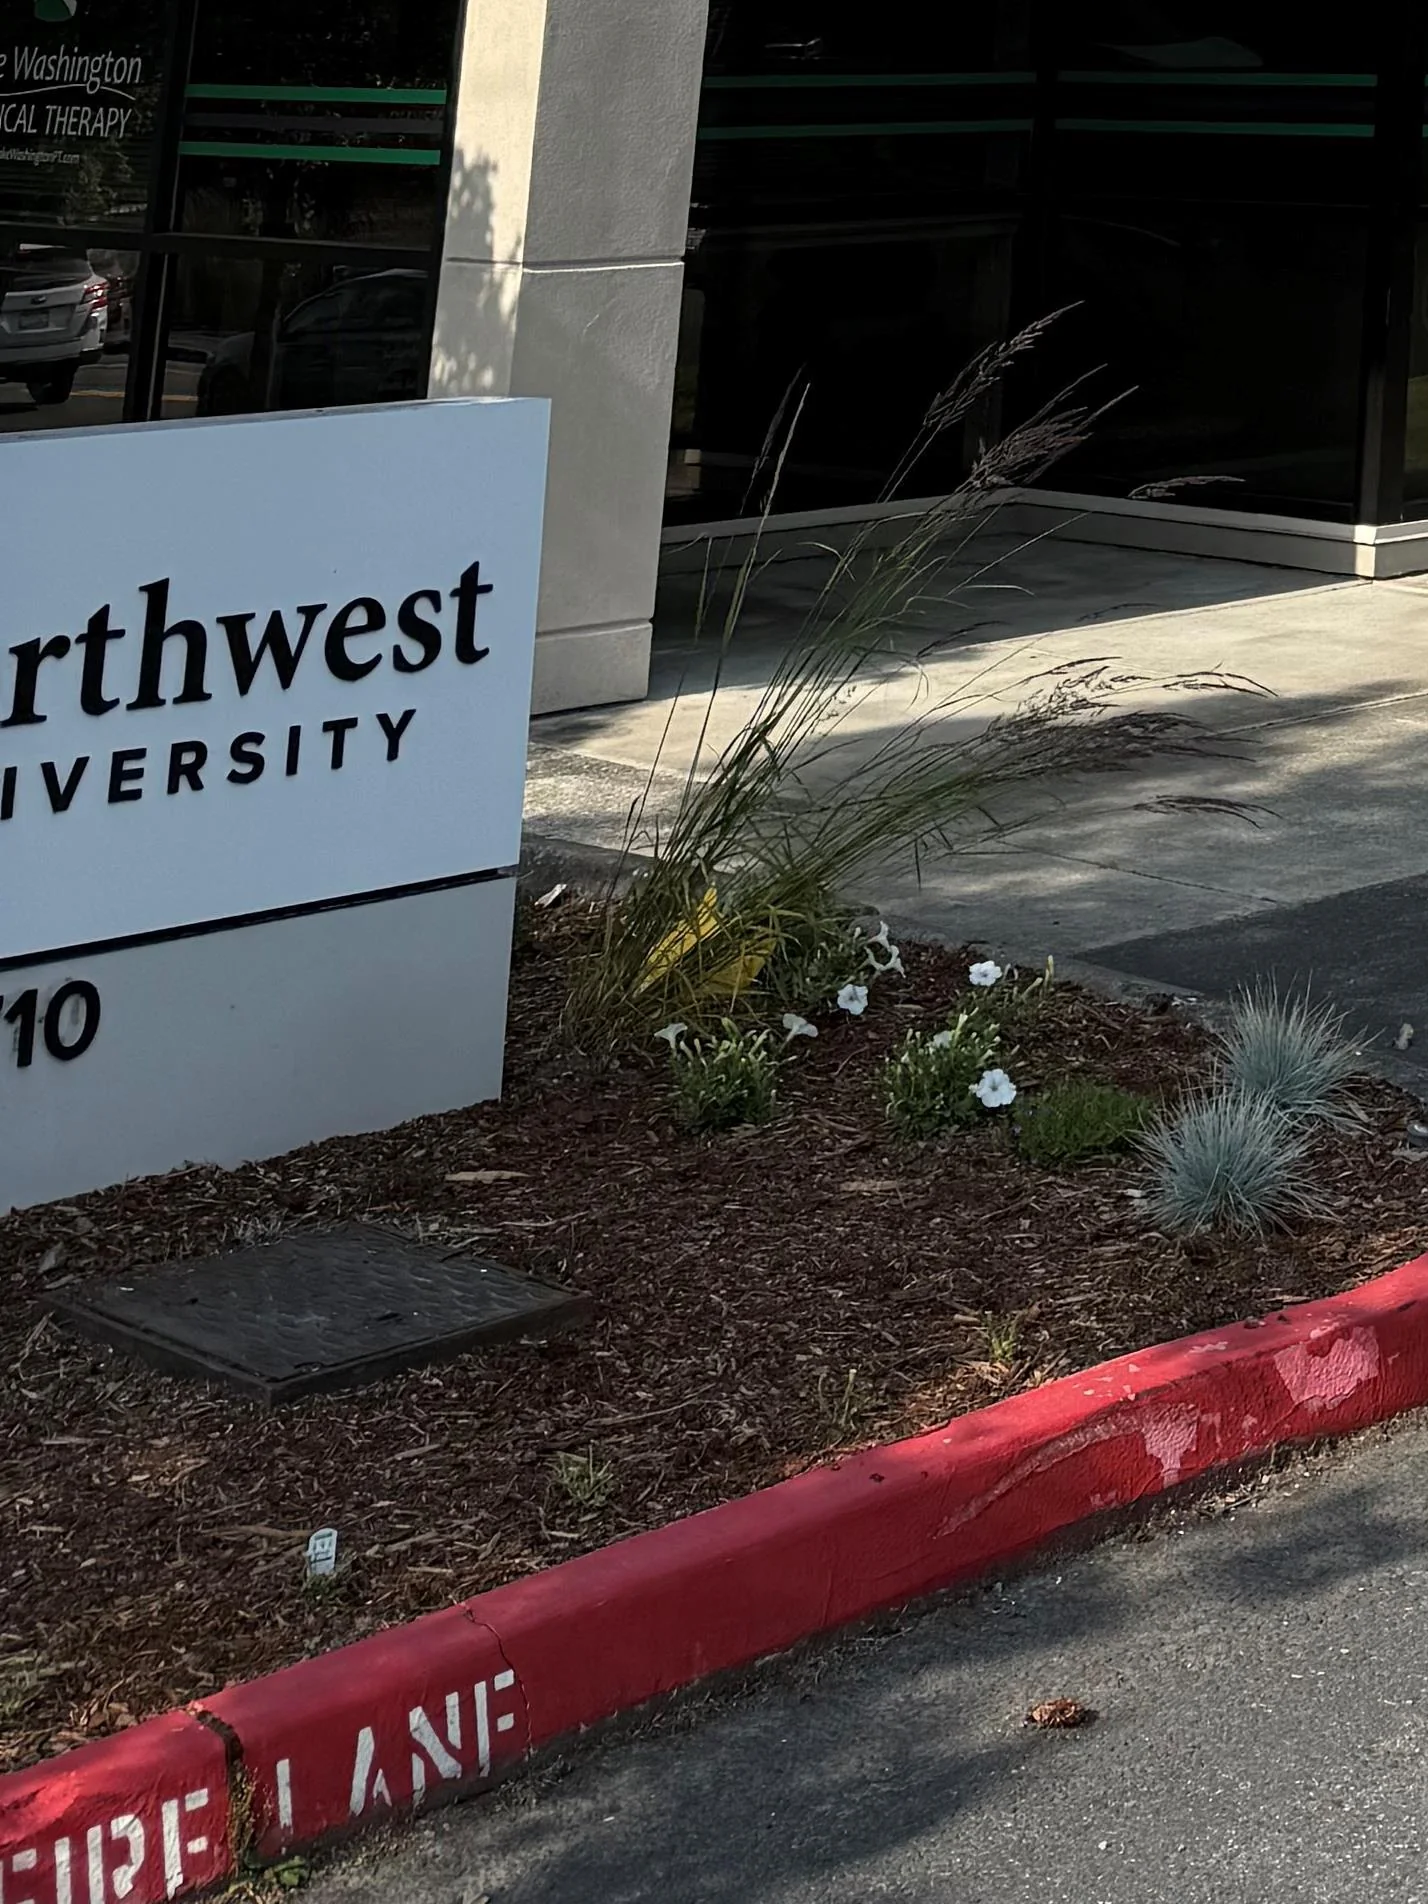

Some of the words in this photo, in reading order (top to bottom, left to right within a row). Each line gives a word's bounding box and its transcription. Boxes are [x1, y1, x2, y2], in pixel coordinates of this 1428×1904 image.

[14, 44, 142, 94] Washington
[45, 105, 132, 139] THERAPY
[0, 561, 494, 728] rthwest
[0, 708, 416, 821] IVERSITY
[0, 979, 101, 1068] 10
